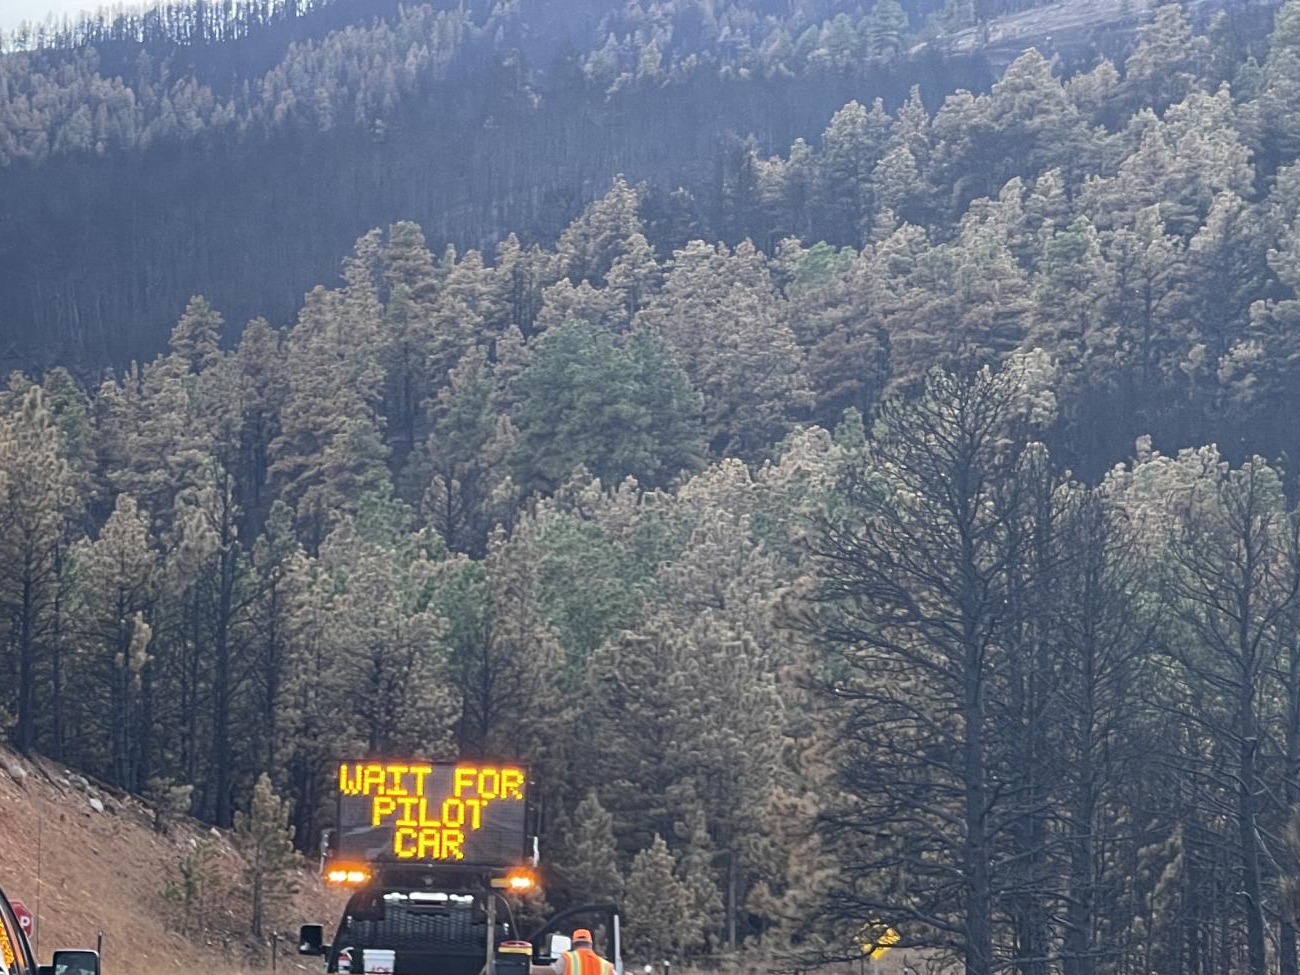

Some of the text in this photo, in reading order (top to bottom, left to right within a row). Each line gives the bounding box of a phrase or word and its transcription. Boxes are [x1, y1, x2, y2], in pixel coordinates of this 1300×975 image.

[339, 763, 525, 799] WAIT FOR
[372, 796, 488, 829] PILOT
[394, 827, 465, 859] CAR
